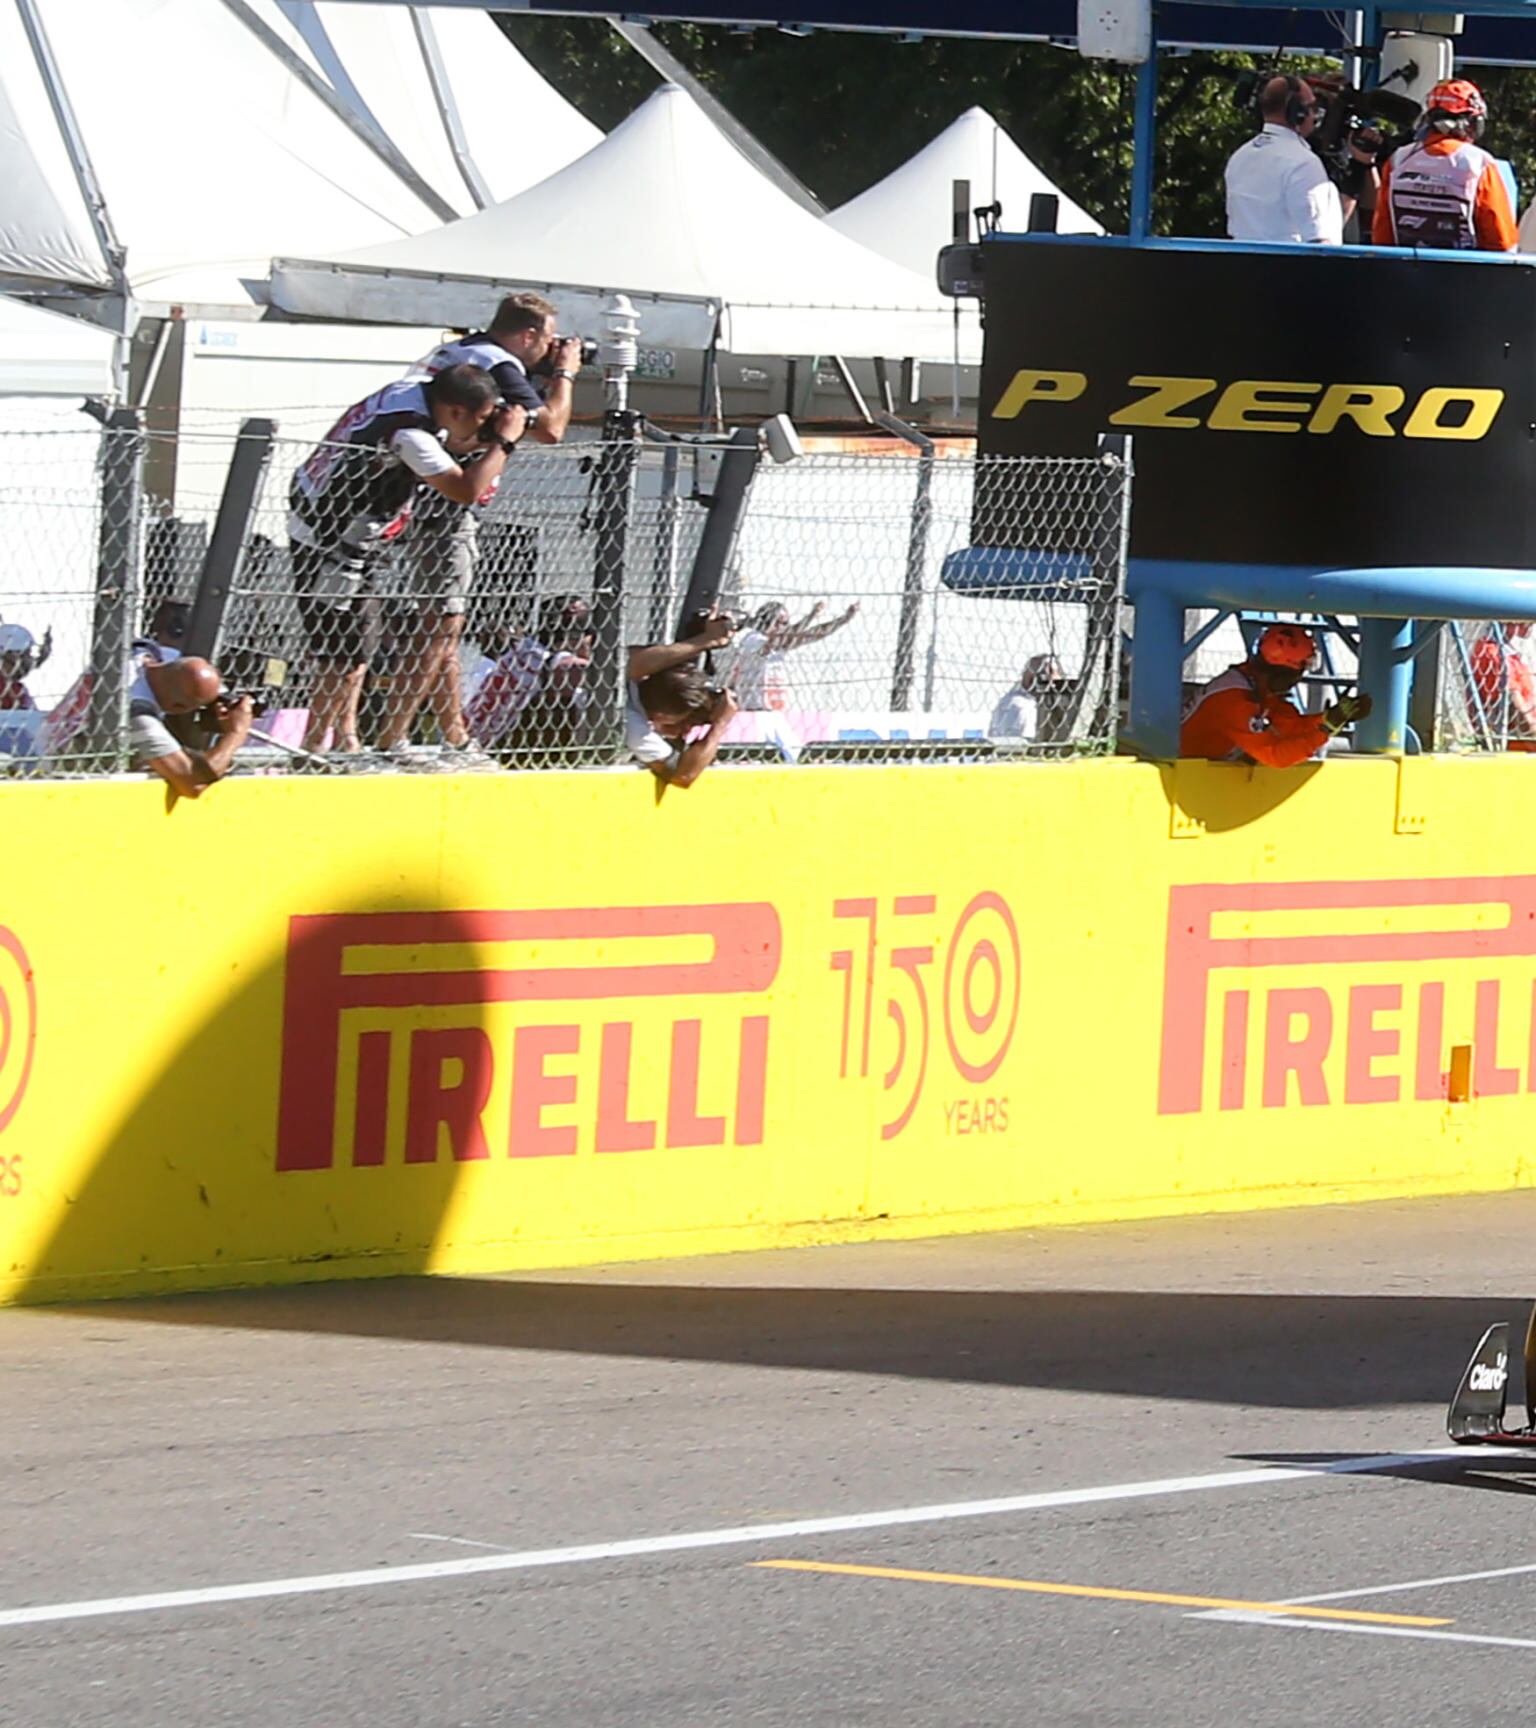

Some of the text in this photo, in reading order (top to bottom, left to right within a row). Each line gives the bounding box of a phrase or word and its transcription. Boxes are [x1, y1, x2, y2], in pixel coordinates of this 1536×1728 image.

[991, 369, 1505, 440] P ZERO
[276, 901, 783, 1172] PIRELLI
[830, 890, 1021, 1141] 150
[943, 1096, 1010, 1136] YEARS
